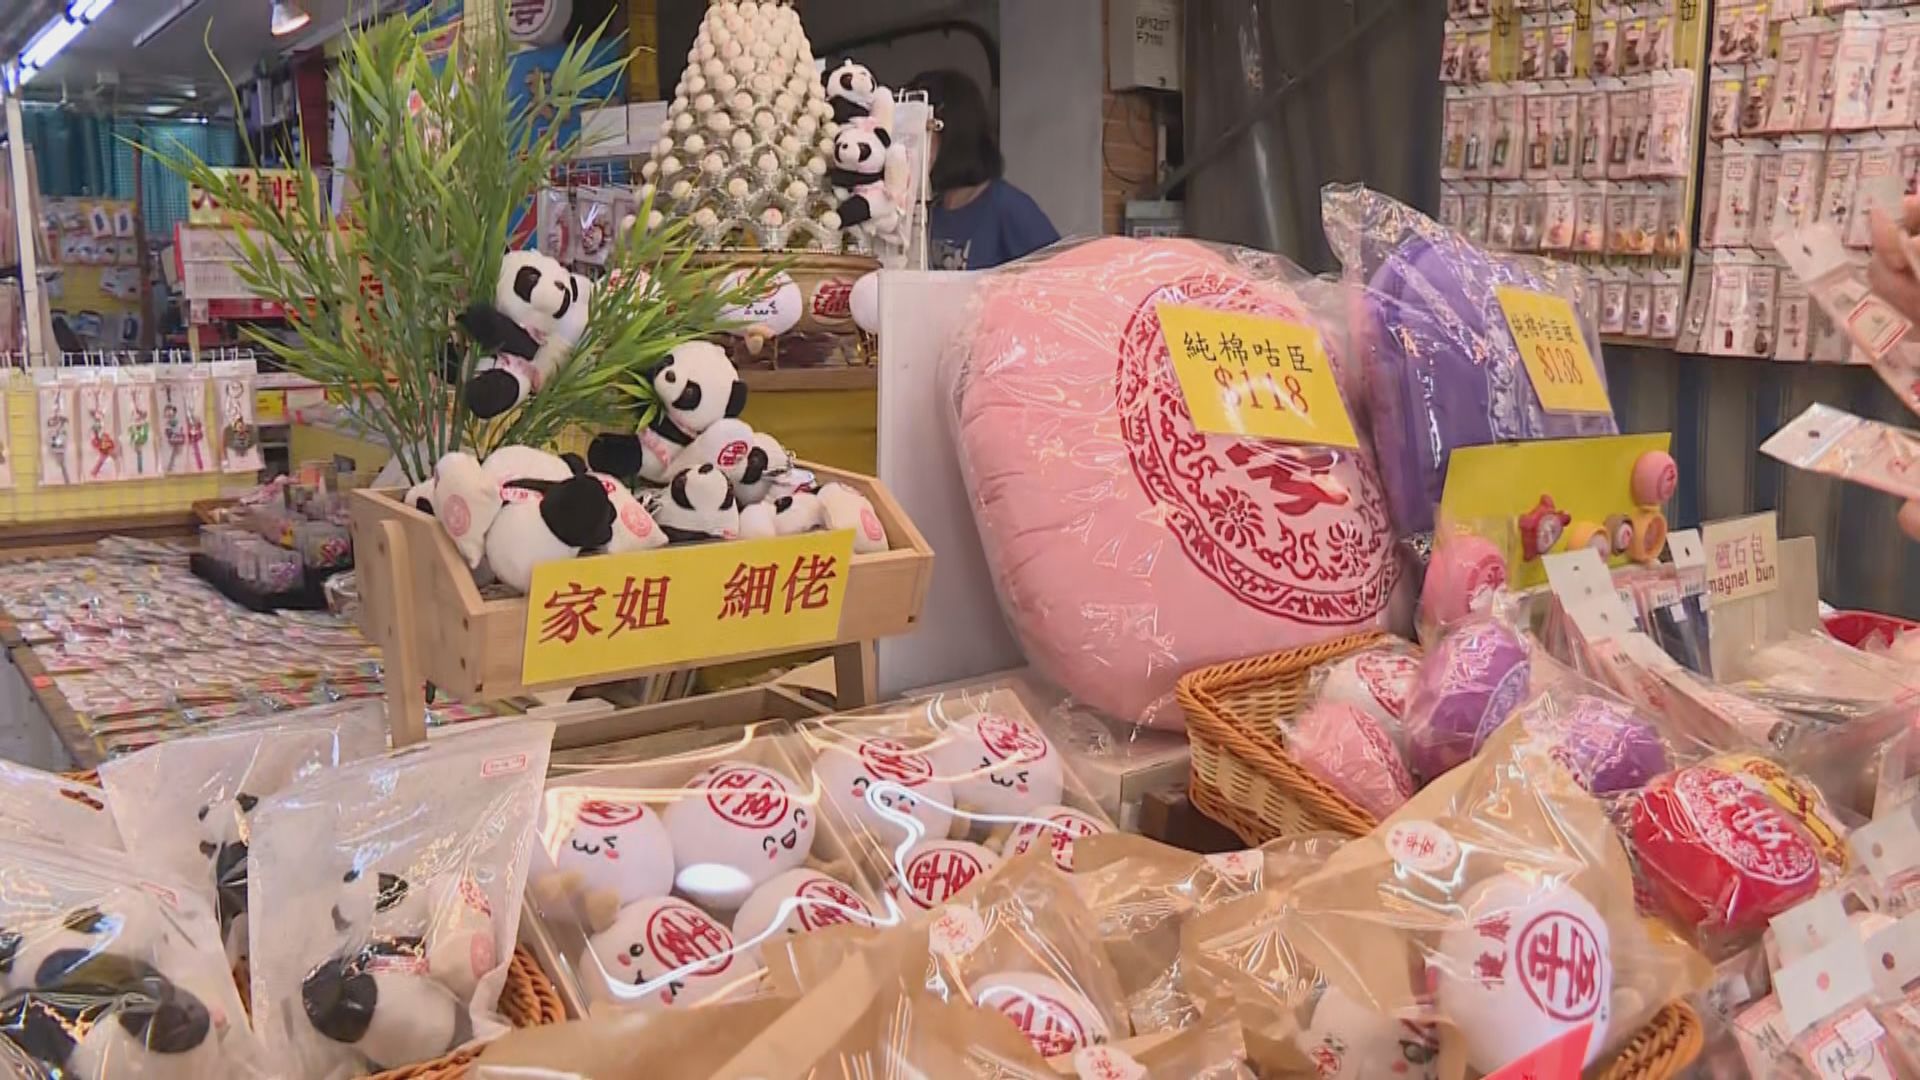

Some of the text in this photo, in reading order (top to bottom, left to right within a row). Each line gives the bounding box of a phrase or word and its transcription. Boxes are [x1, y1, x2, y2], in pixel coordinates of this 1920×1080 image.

[1183, 331, 1313, 373] 純棉咕臣
[1214, 364, 1310, 414] $118
[1755, 564, 1775, 583] bun
[539, 554, 837, 644] 家姐 細佬
[1528, 922, 1597, 1009] 平安
